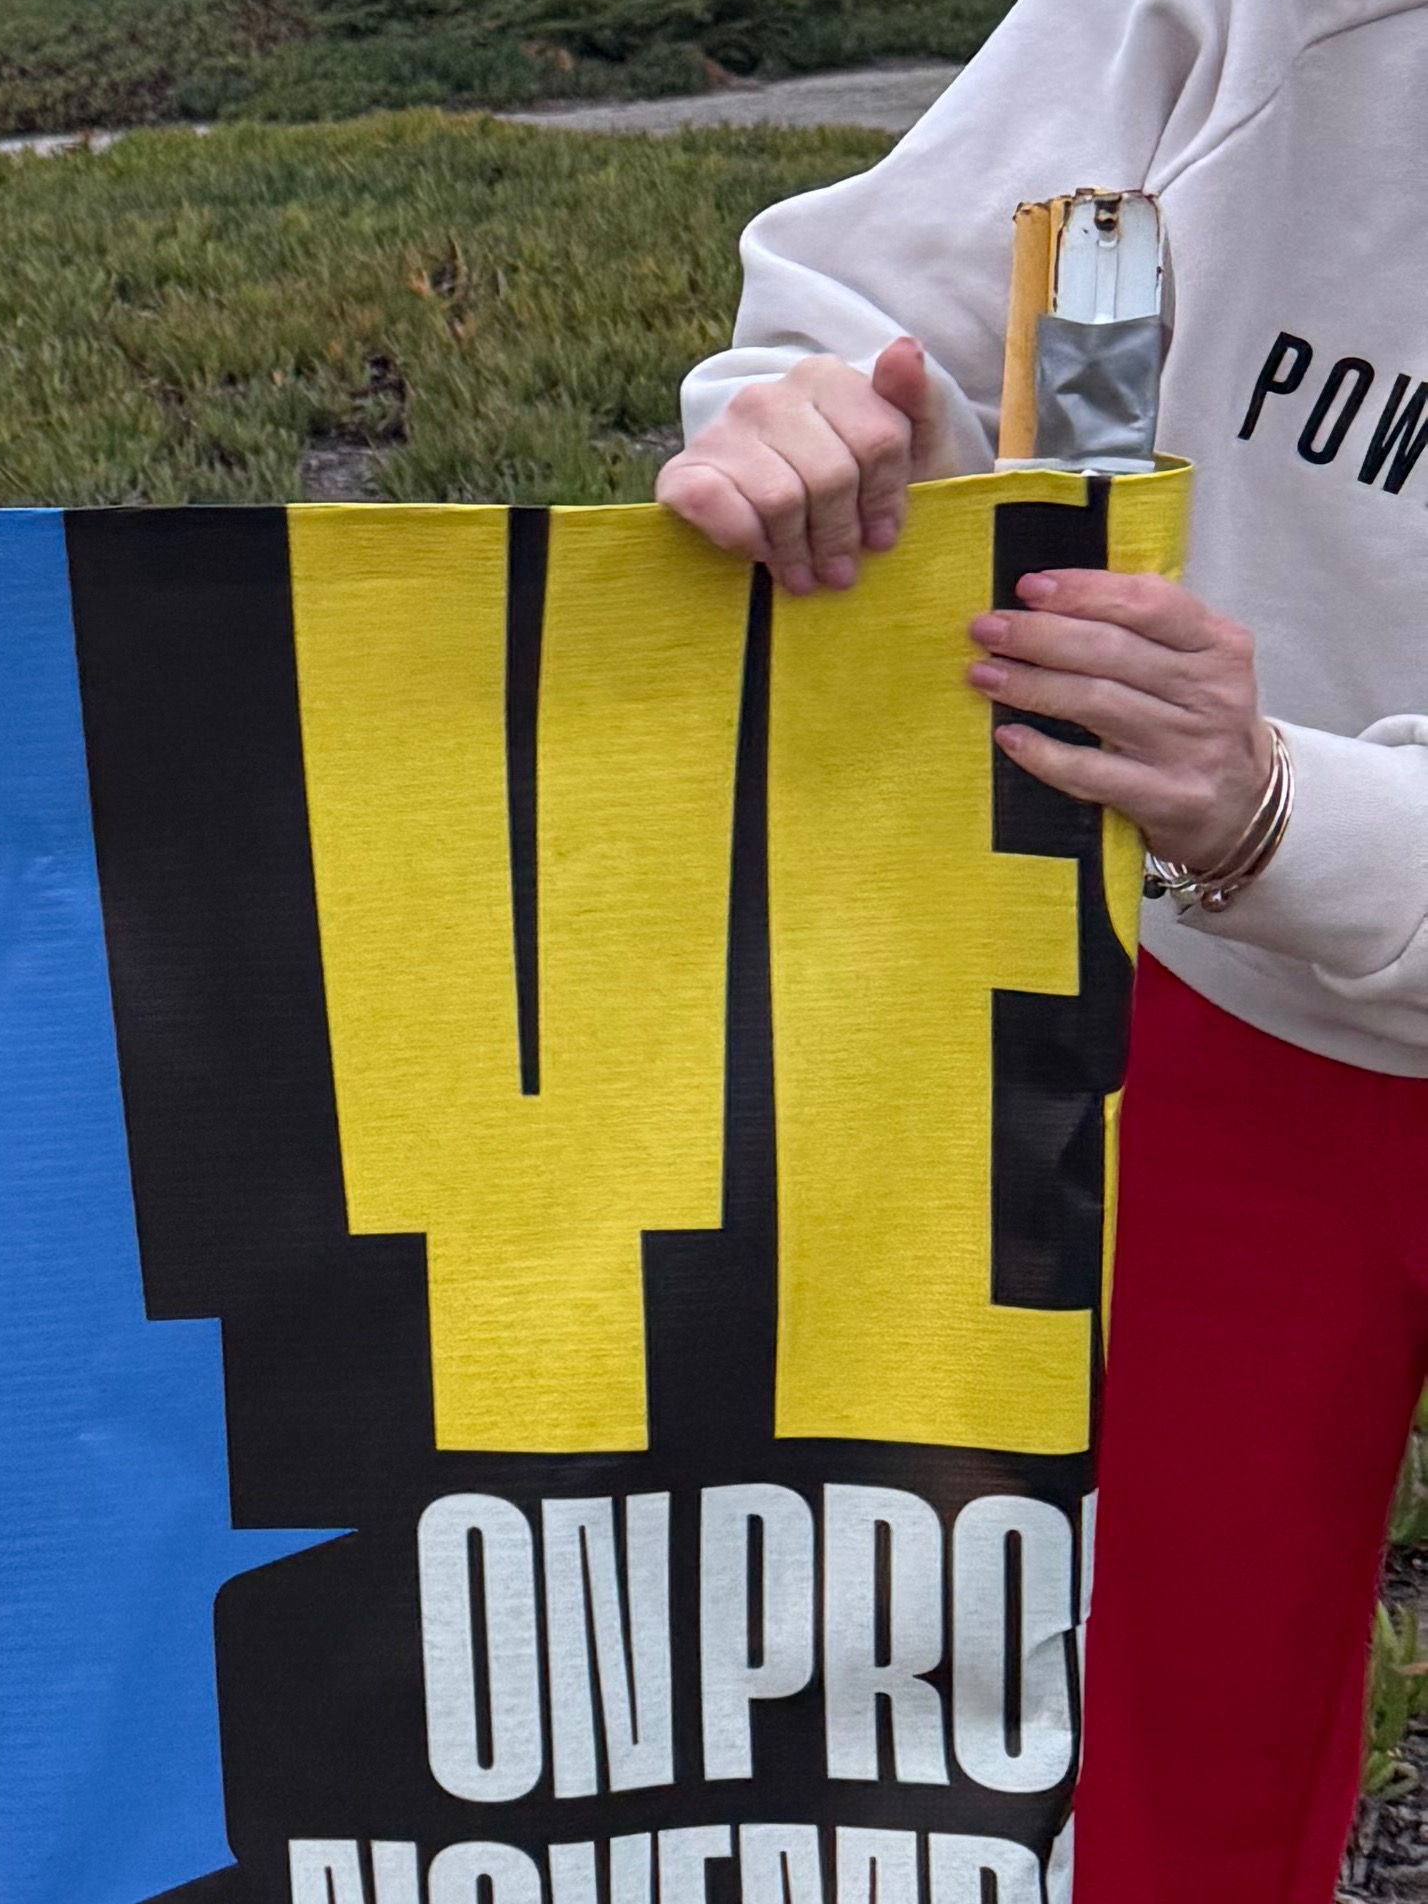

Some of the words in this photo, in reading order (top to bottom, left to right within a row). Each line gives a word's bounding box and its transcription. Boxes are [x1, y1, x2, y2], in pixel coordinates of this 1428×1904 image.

[288, 457, 1193, 1454] YE
[416, 1491, 674, 1803] ON
[700, 1482, 1099, 1793] PRO
